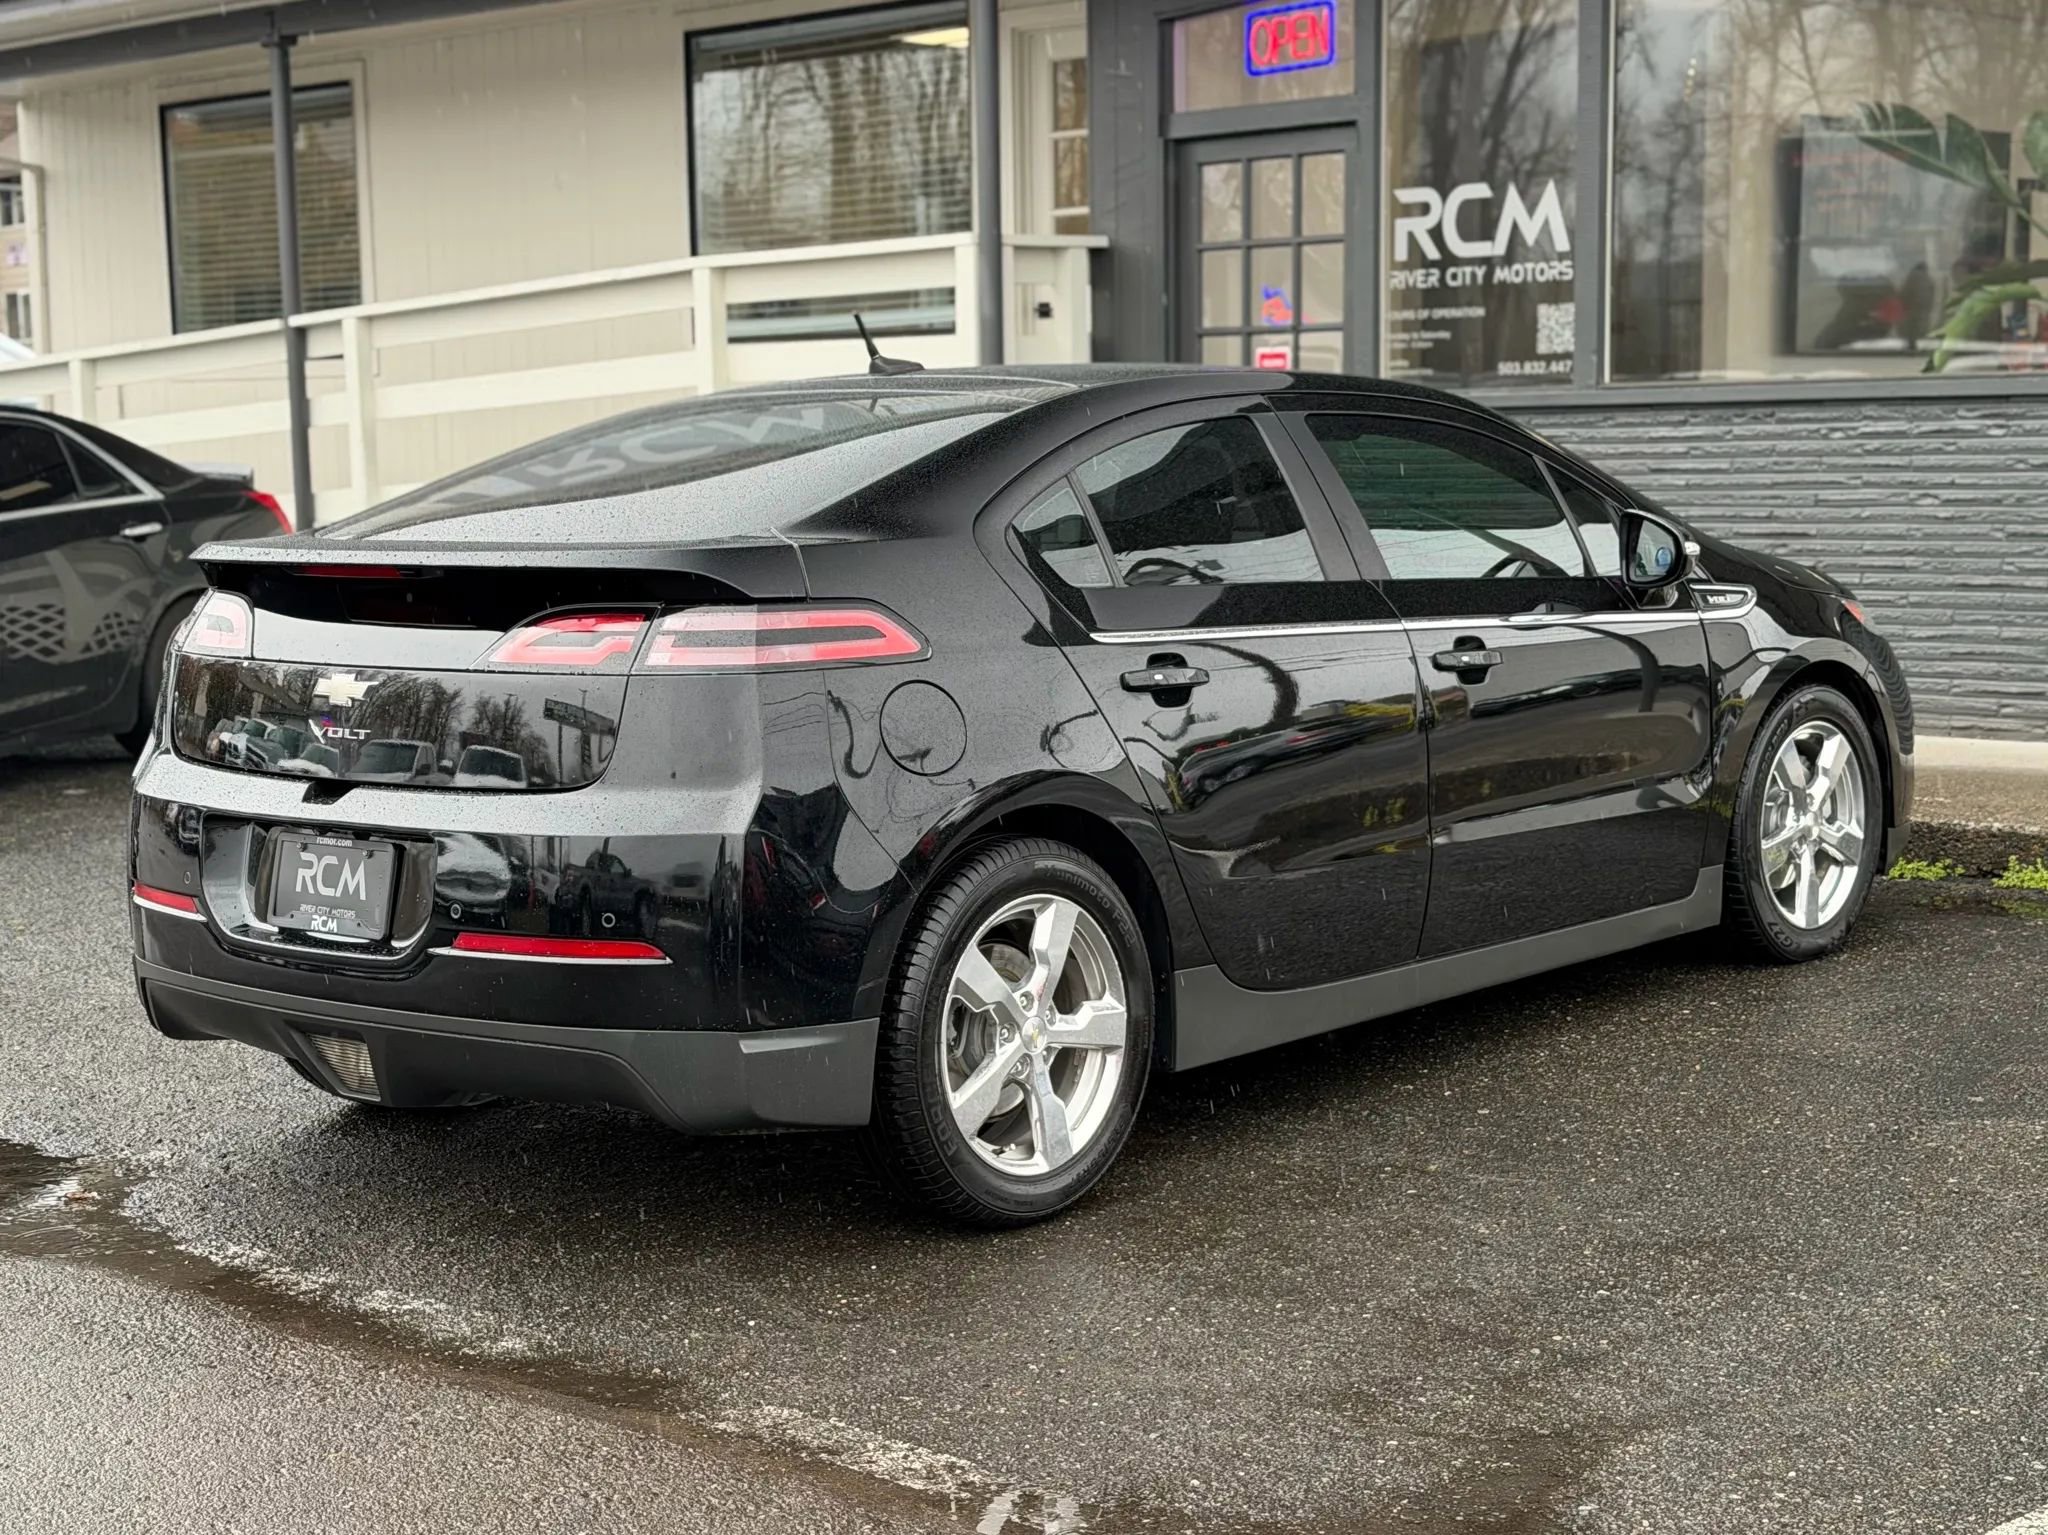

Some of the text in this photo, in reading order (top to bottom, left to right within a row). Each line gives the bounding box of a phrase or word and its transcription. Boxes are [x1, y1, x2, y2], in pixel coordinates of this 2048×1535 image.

[1250, 8, 1330, 67] OPEN
[1393, 179, 1571, 262] RCM
[1390, 260, 1574, 290] RIVER CITY MOTORS
[1497, 360, 1573, 376] 503.832.447
[308, 719, 371, 744] VOLT
[296, 852, 366, 900] RCM
[300, 903, 357, 919] RIVER CITY MOTORS
[311, 914, 338, 933] RCM
